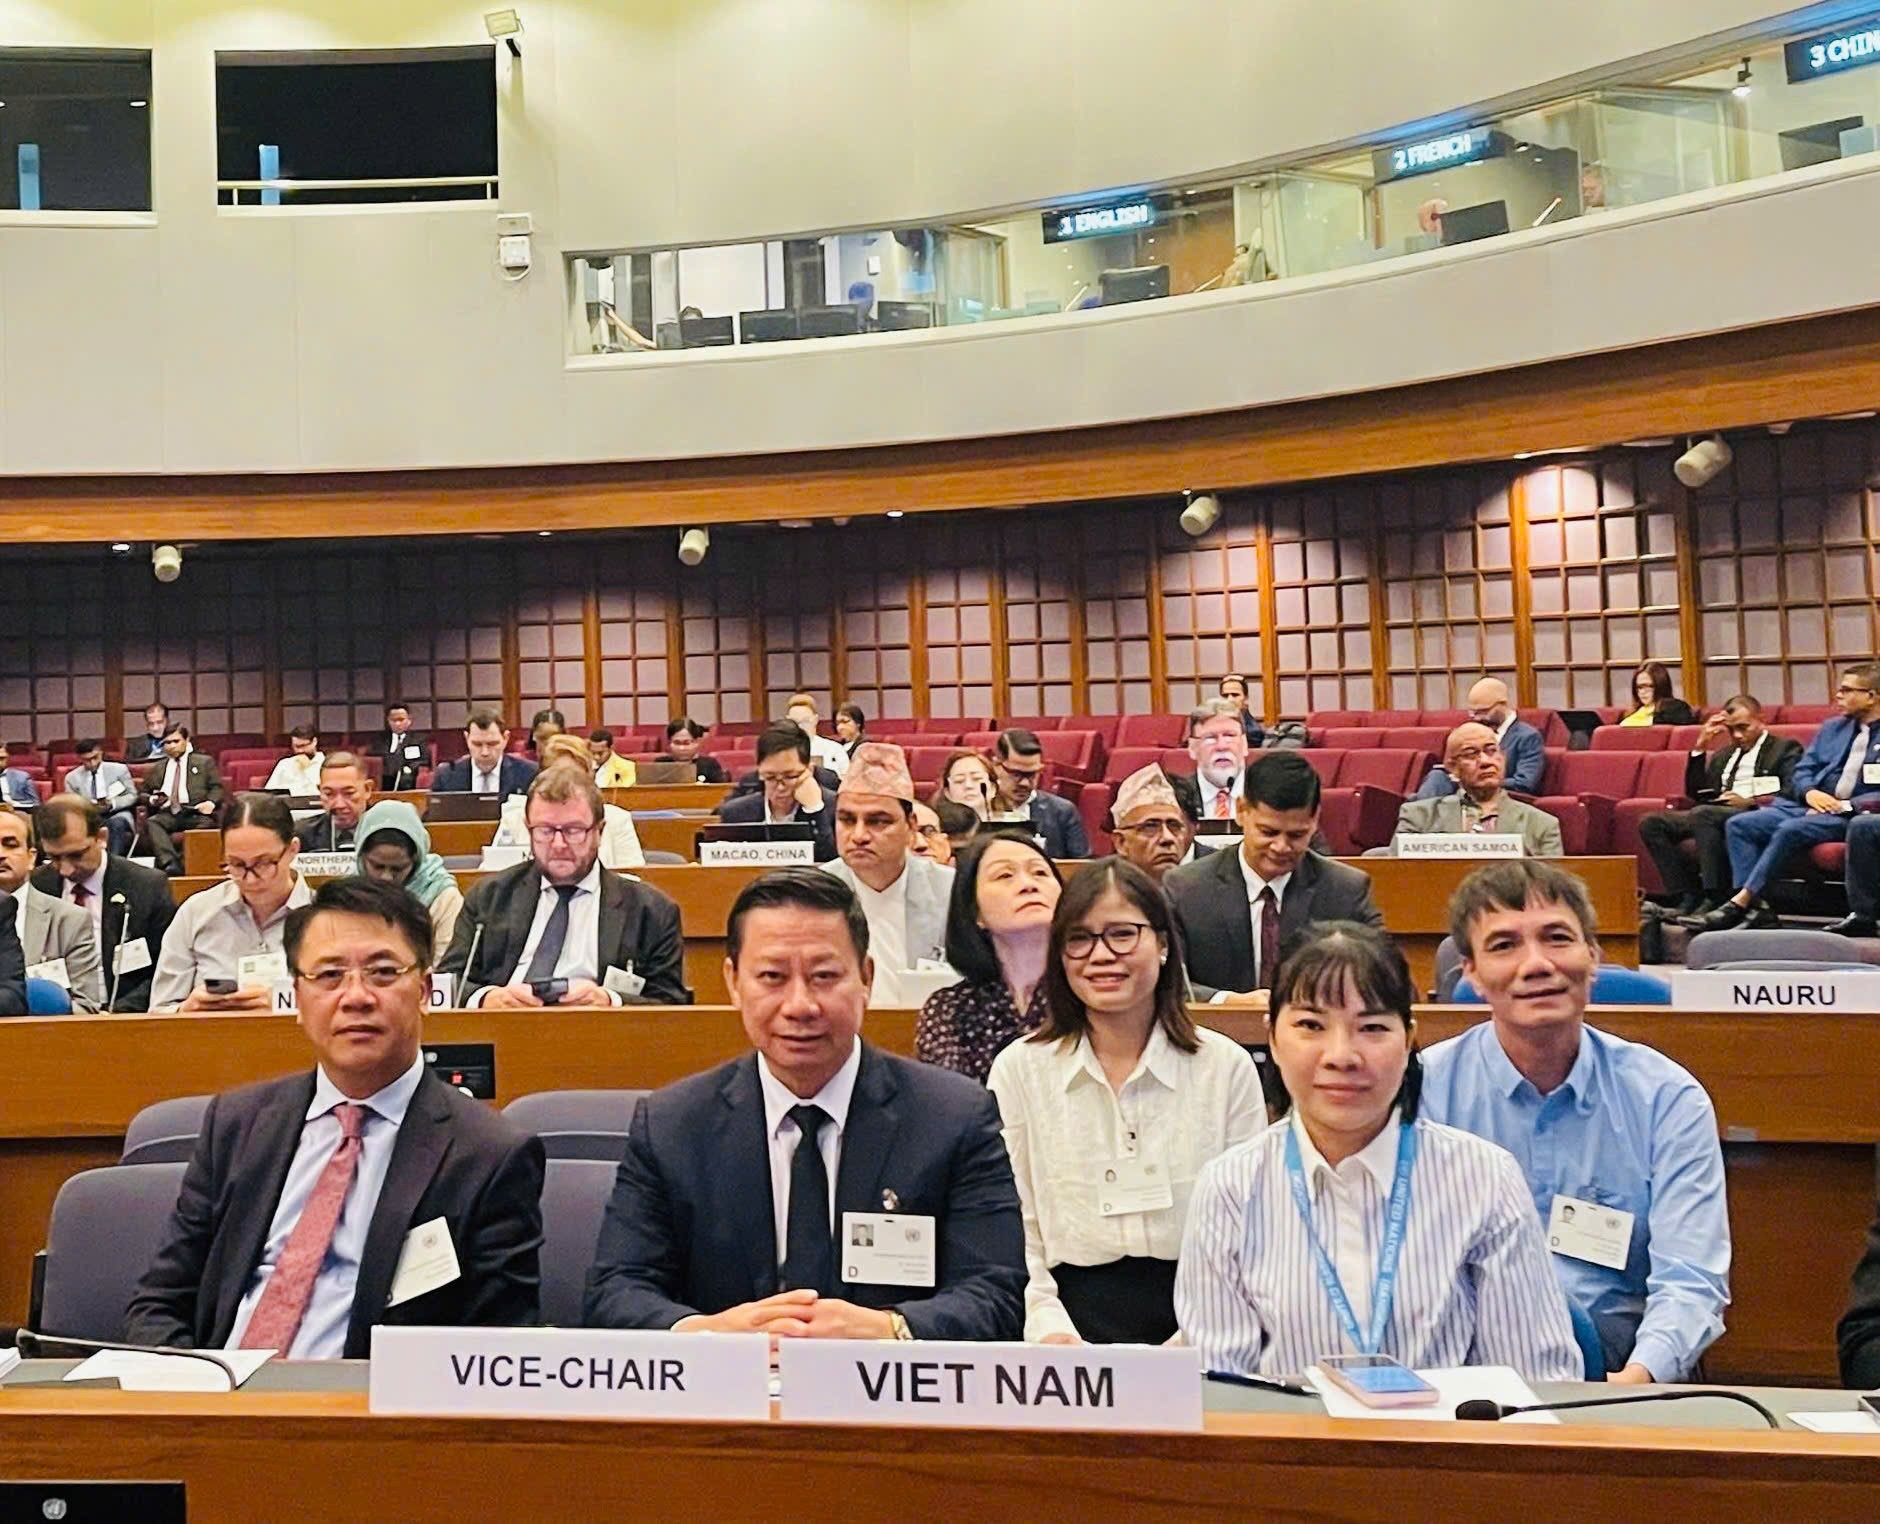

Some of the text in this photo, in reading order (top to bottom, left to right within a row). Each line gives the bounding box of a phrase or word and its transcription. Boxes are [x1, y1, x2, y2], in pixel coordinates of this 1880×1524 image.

[1810, 44, 1826, 68] 3
[1394, 133, 1471, 170] 2 FRENCH
[1075, 204, 1148, 232] ENGLISH
[711, 849, 807, 861] MACAO, CHINA
[1402, 842, 1519, 853] AMERICAN SAMOA
[1733, 984, 1836, 1006] NAURU
[1551, 1235, 1561, 1247] D
[848, 1265, 859, 1278] D
[451, 1354, 686, 1392] VICE-CHAIR
[856, 1360, 1115, 1407] VIET NAM
